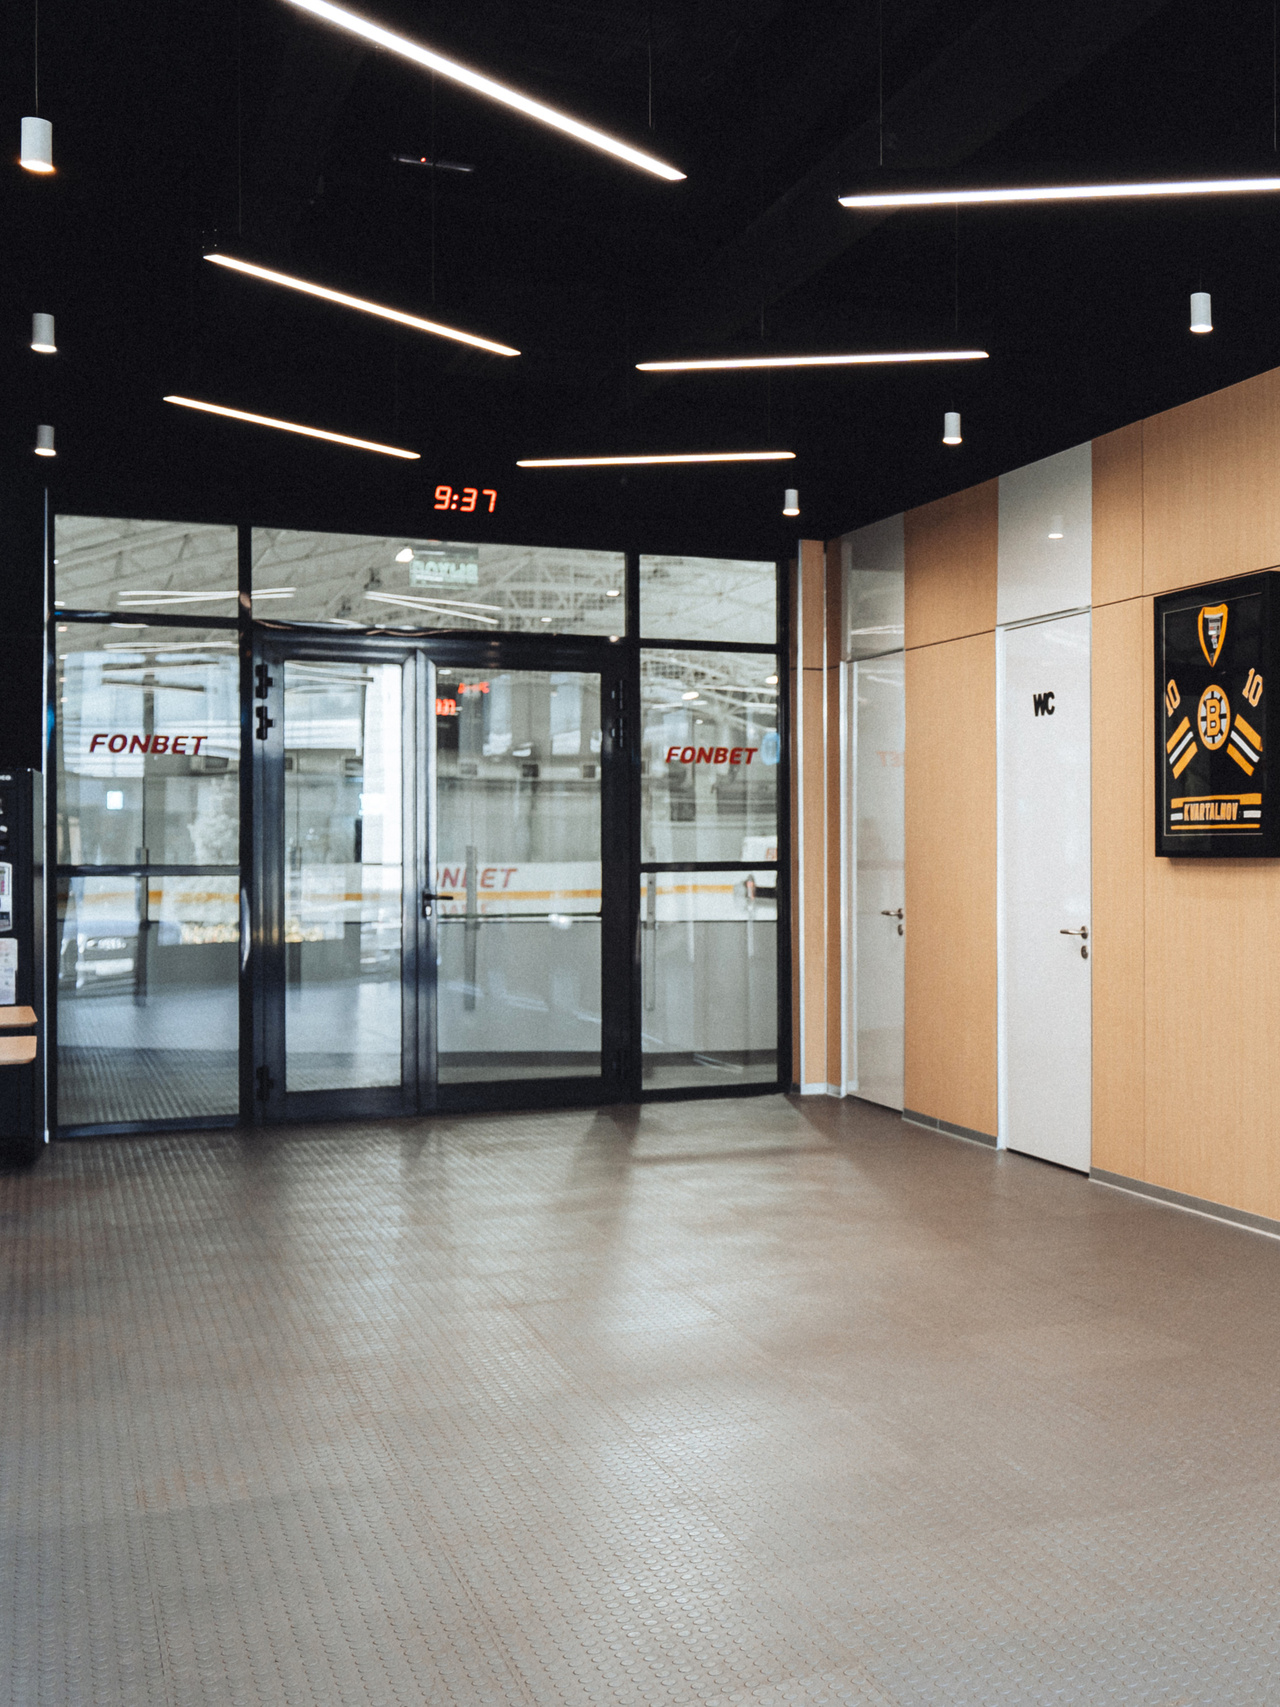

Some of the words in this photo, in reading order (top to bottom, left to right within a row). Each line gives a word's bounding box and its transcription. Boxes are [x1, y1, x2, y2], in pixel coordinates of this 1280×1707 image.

[434, 485, 498, 513] 9:37
[1242, 667, 1263, 708] 10
[1033, 691, 1055, 717] WC
[89, 733, 208, 755] FONBET
[665, 746, 758, 765] FONBET
[1183, 802, 1239, 821] KVARTALNOV
